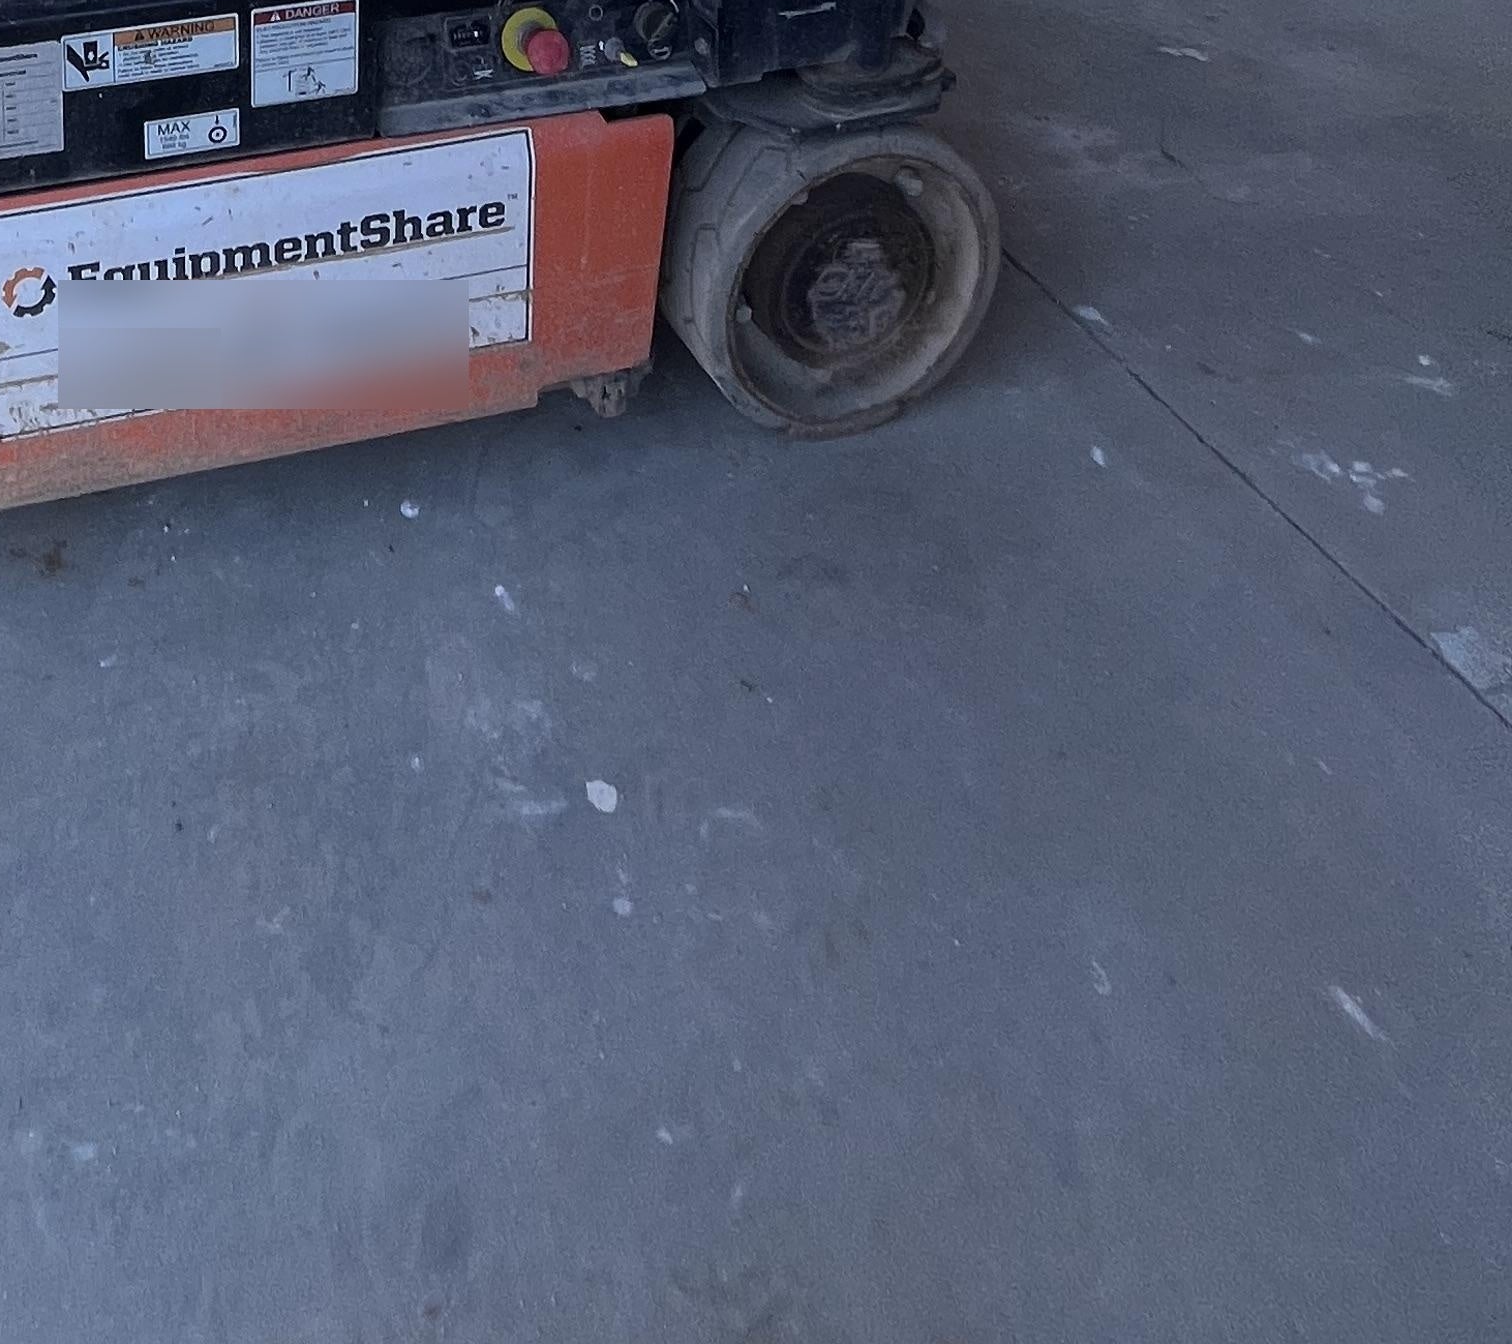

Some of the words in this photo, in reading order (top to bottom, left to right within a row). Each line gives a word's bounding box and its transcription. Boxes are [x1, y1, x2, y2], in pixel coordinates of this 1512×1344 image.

[285, 3, 340, 20] DANGER
[148, 21, 215, 40] WARNING
[158, 120, 191, 136] MAX
